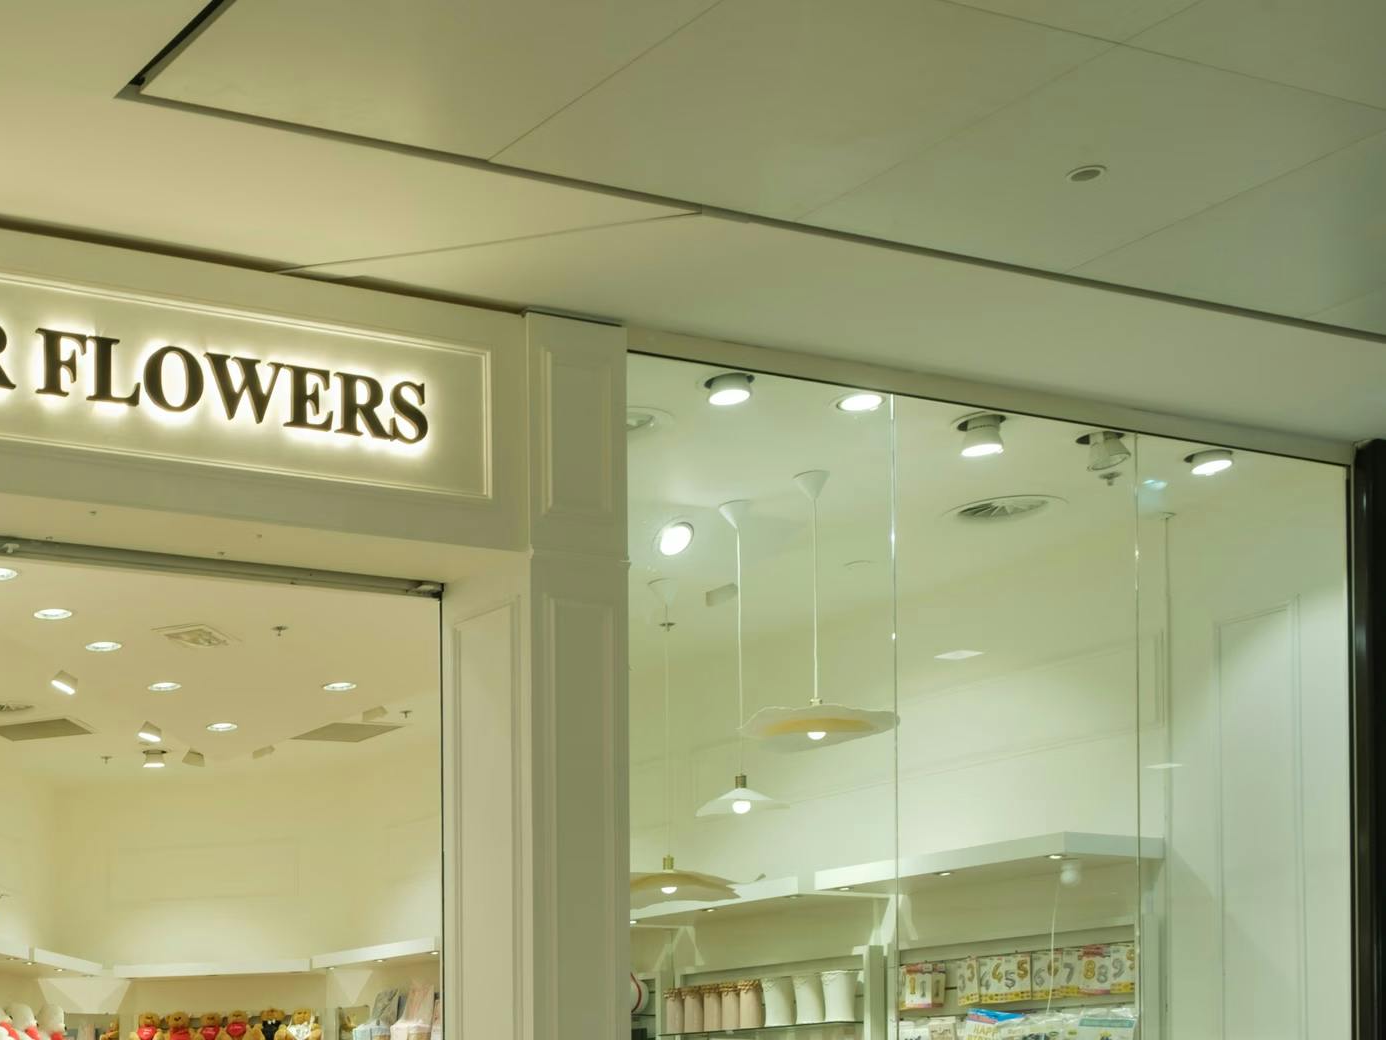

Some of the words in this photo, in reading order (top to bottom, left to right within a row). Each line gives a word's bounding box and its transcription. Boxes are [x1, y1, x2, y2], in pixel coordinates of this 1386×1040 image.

[34, 327, 431, 445] FLOWERS
[1004, 969, 1016, 989] 5
[1017, 959, 1029, 981] 5
[1083, 959, 1095, 980] 8
[1096, 964, 1109, 984] 8
